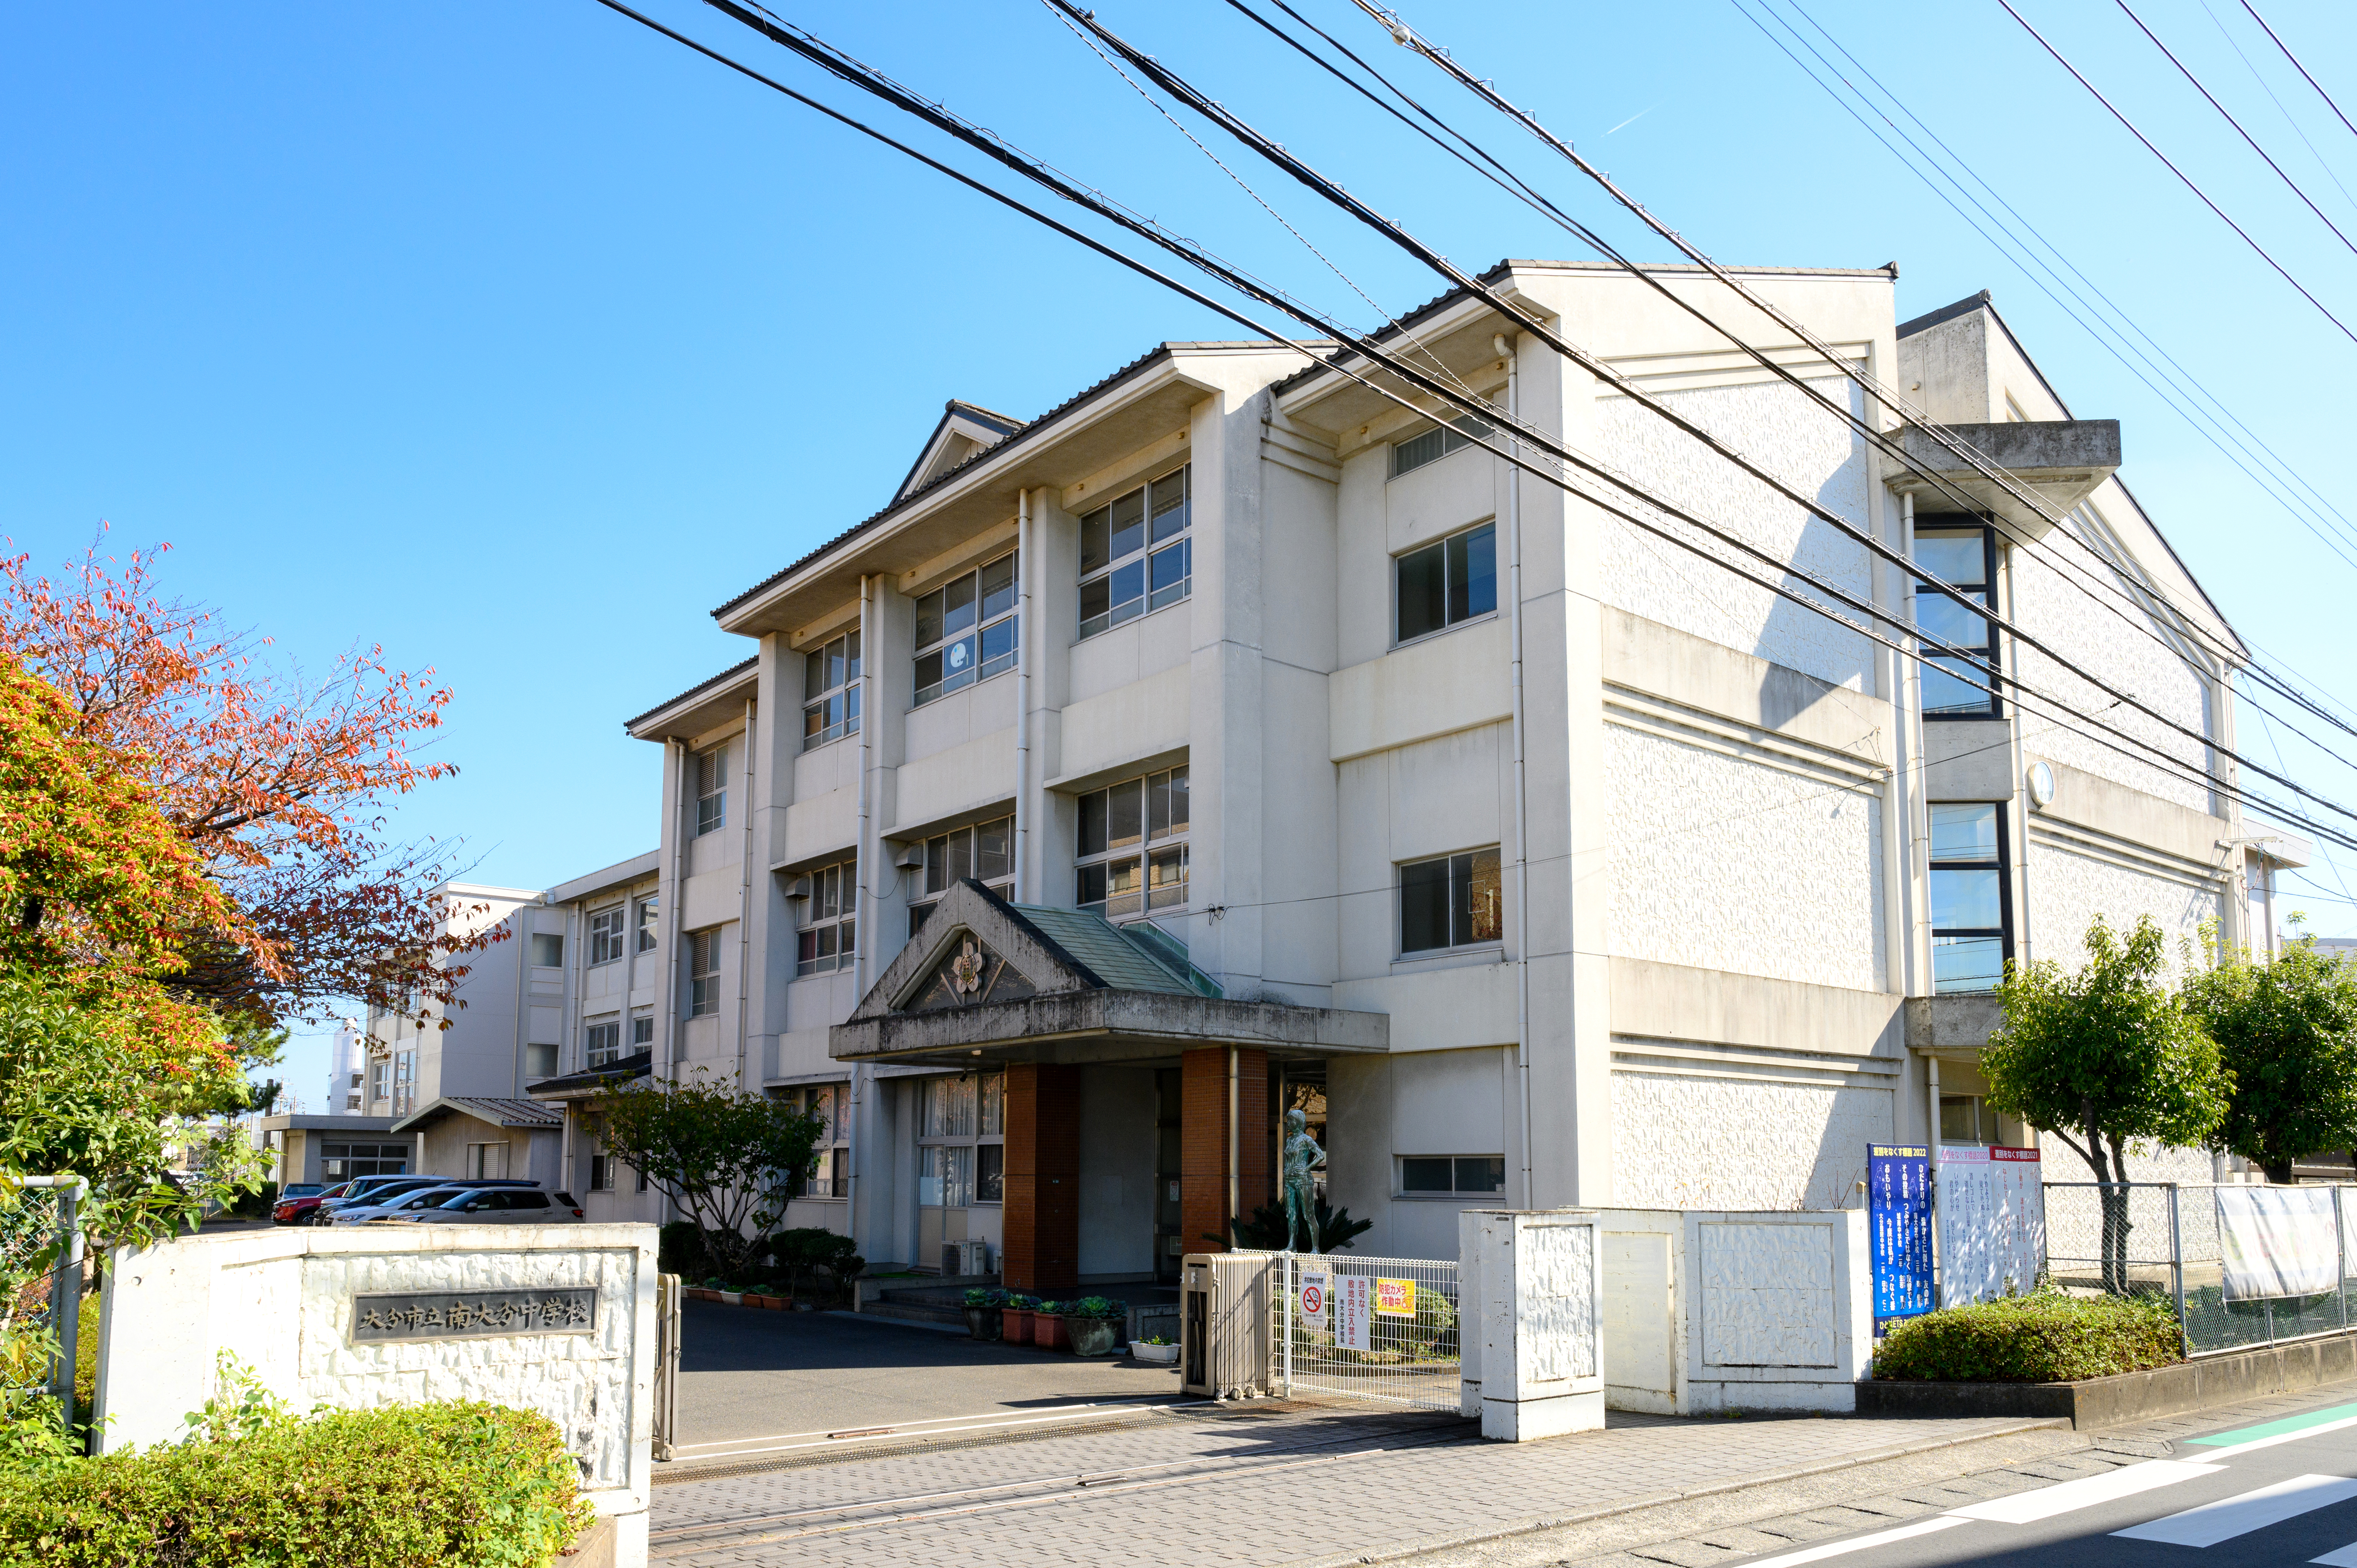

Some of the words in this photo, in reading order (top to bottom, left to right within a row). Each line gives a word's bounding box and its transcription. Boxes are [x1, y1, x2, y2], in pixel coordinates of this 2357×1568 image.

[1379, 1284, 1406, 1295] 防犯カメラ
[1382, 1296, 1401, 1307] 作動中
[360, 1297, 591, 1330] 大分市立南大分中学校
